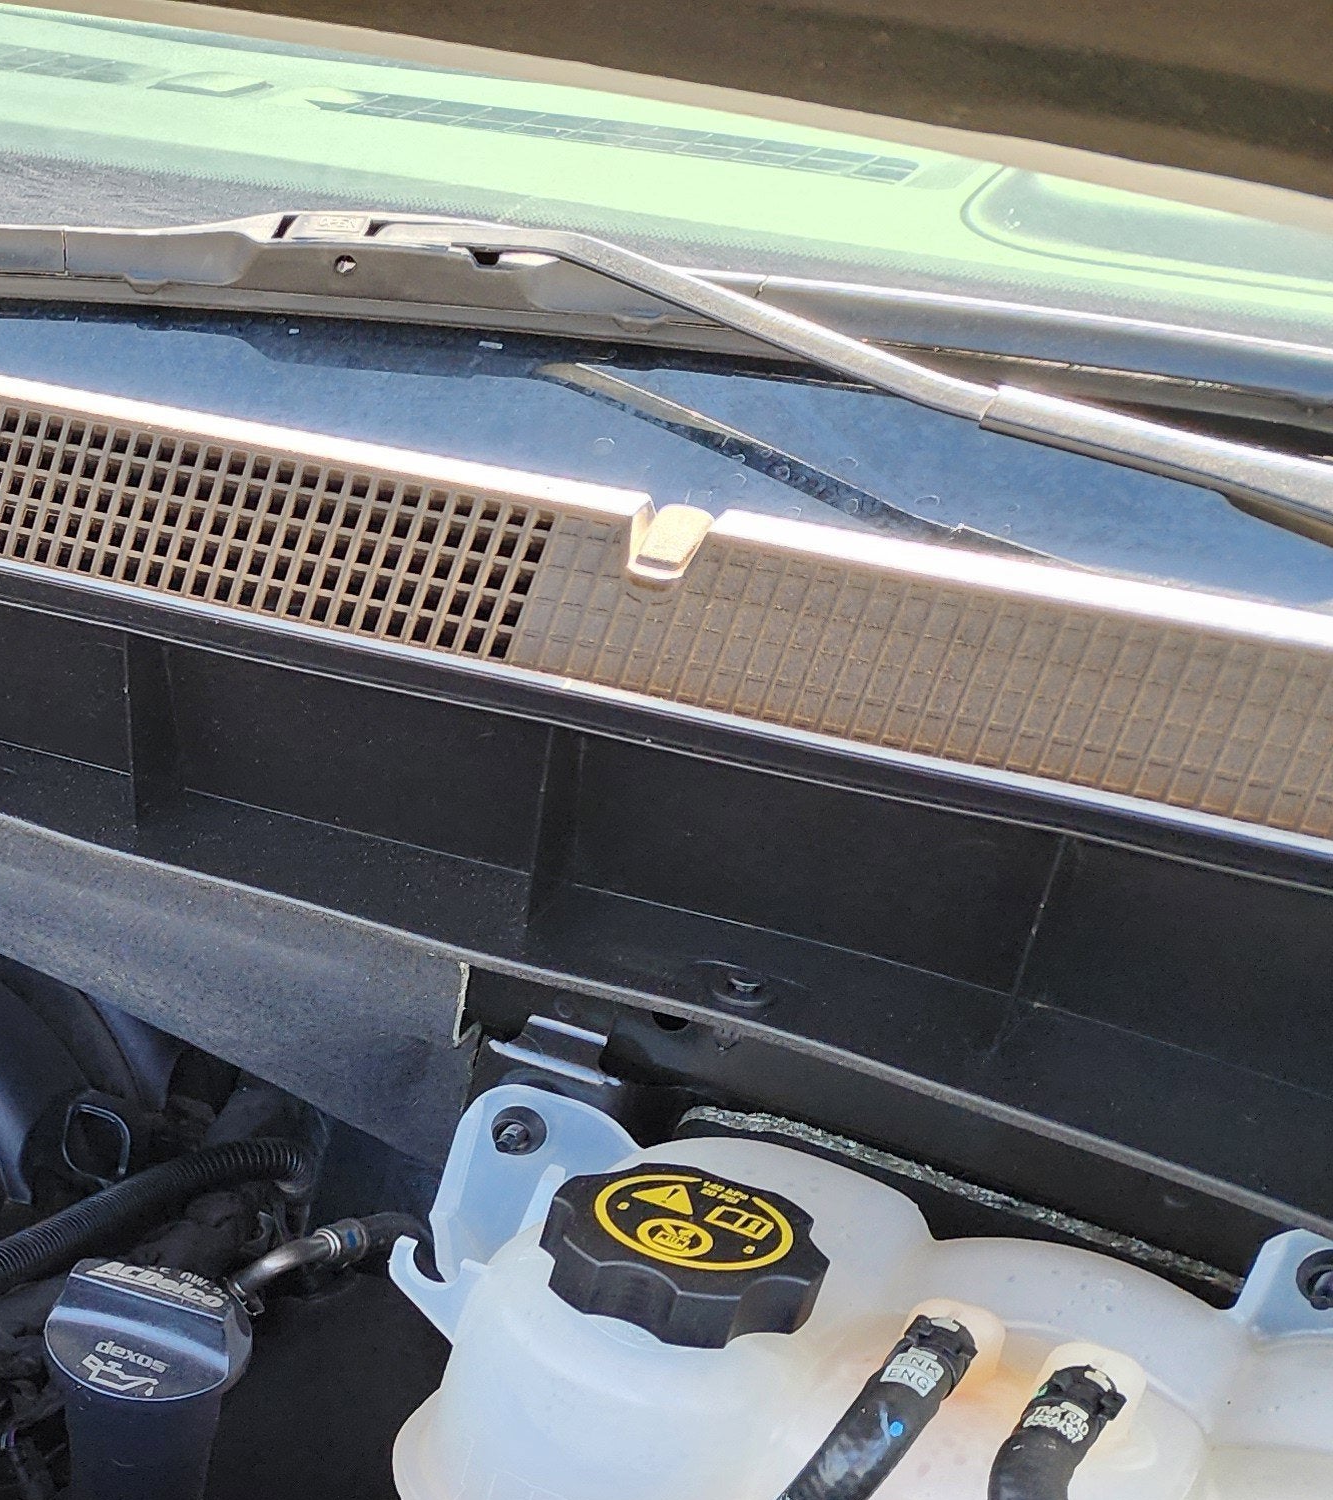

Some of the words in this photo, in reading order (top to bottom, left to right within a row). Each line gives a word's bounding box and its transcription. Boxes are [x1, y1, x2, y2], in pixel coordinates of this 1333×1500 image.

[88, 1261, 225, 1309] ACDelco
[94, 1340, 169, 1374] dexos
[887, 1366, 930, 1391] ENG
